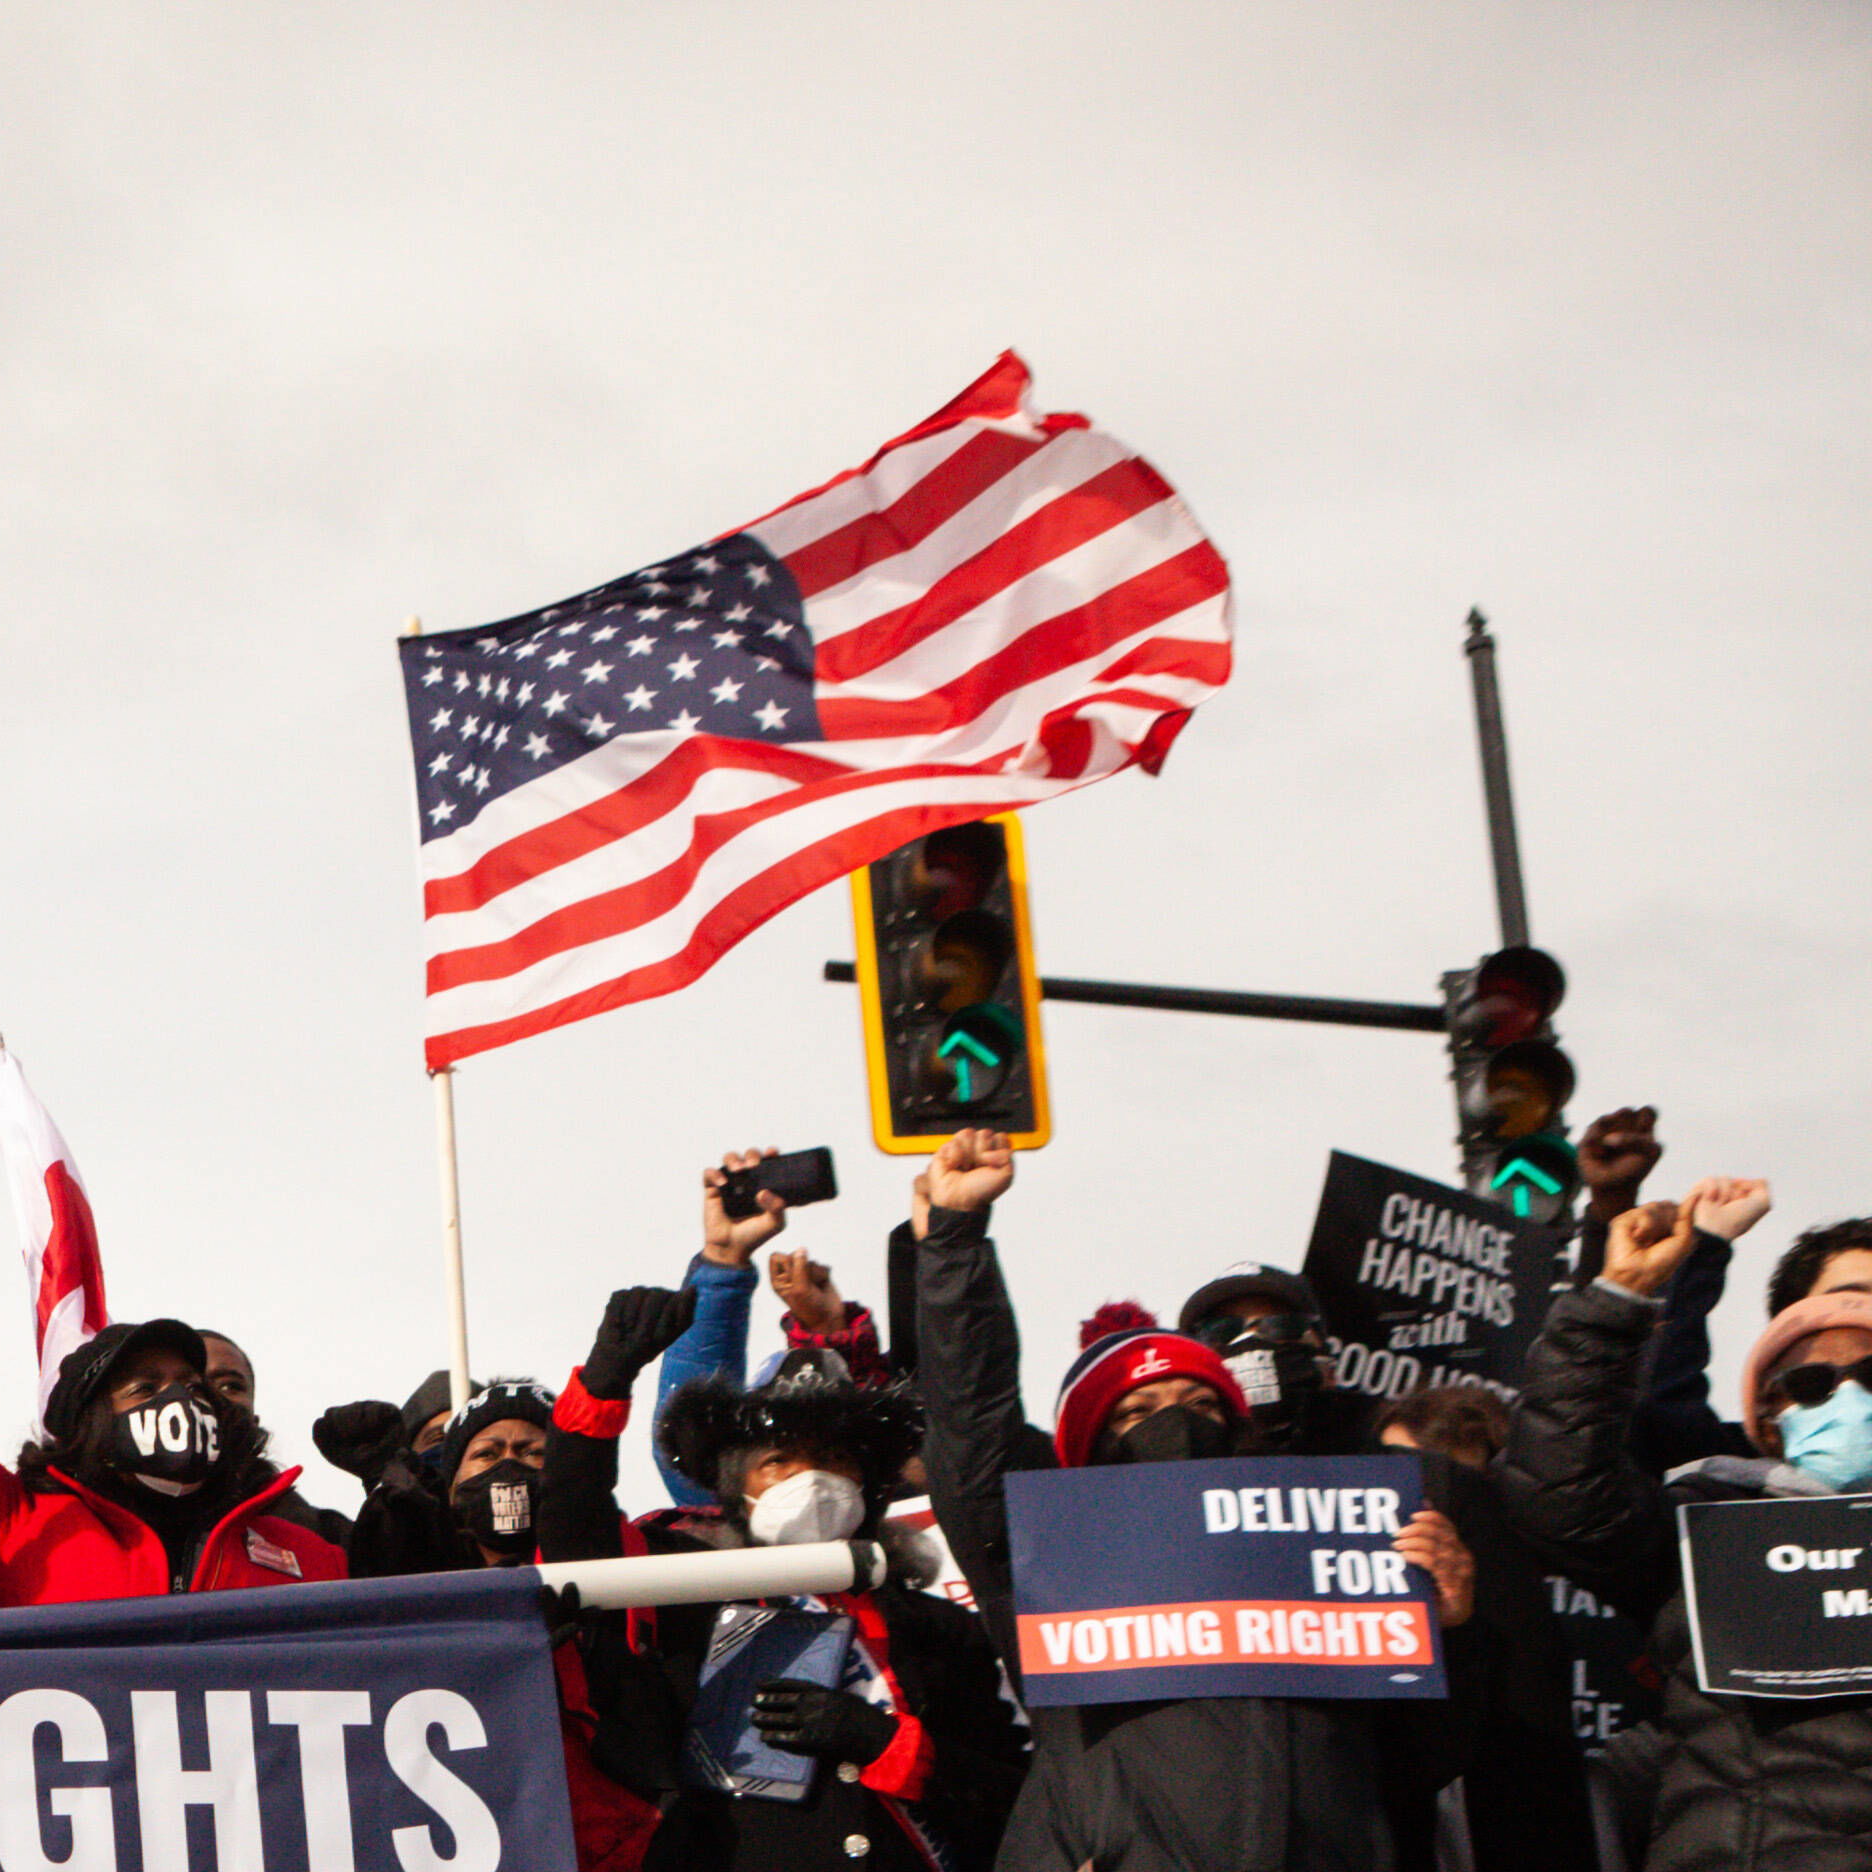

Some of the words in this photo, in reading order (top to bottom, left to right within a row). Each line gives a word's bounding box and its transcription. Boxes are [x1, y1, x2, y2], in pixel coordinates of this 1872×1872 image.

[1381, 1193, 1515, 1277] CHANGE
[1358, 1238, 1516, 1328] HAPPENS
[1389, 1311, 1467, 1350] with
[128, 1401, 220, 1462] VOTE
[1202, 1488, 1400, 1534] DELIVER
[1311, 1549, 1410, 1595] FOR
[1765, 1545, 1864, 1573] Our
[1040, 1611, 1224, 1665] VOTING
[1235, 1609, 1420, 1656] RIGHTS
